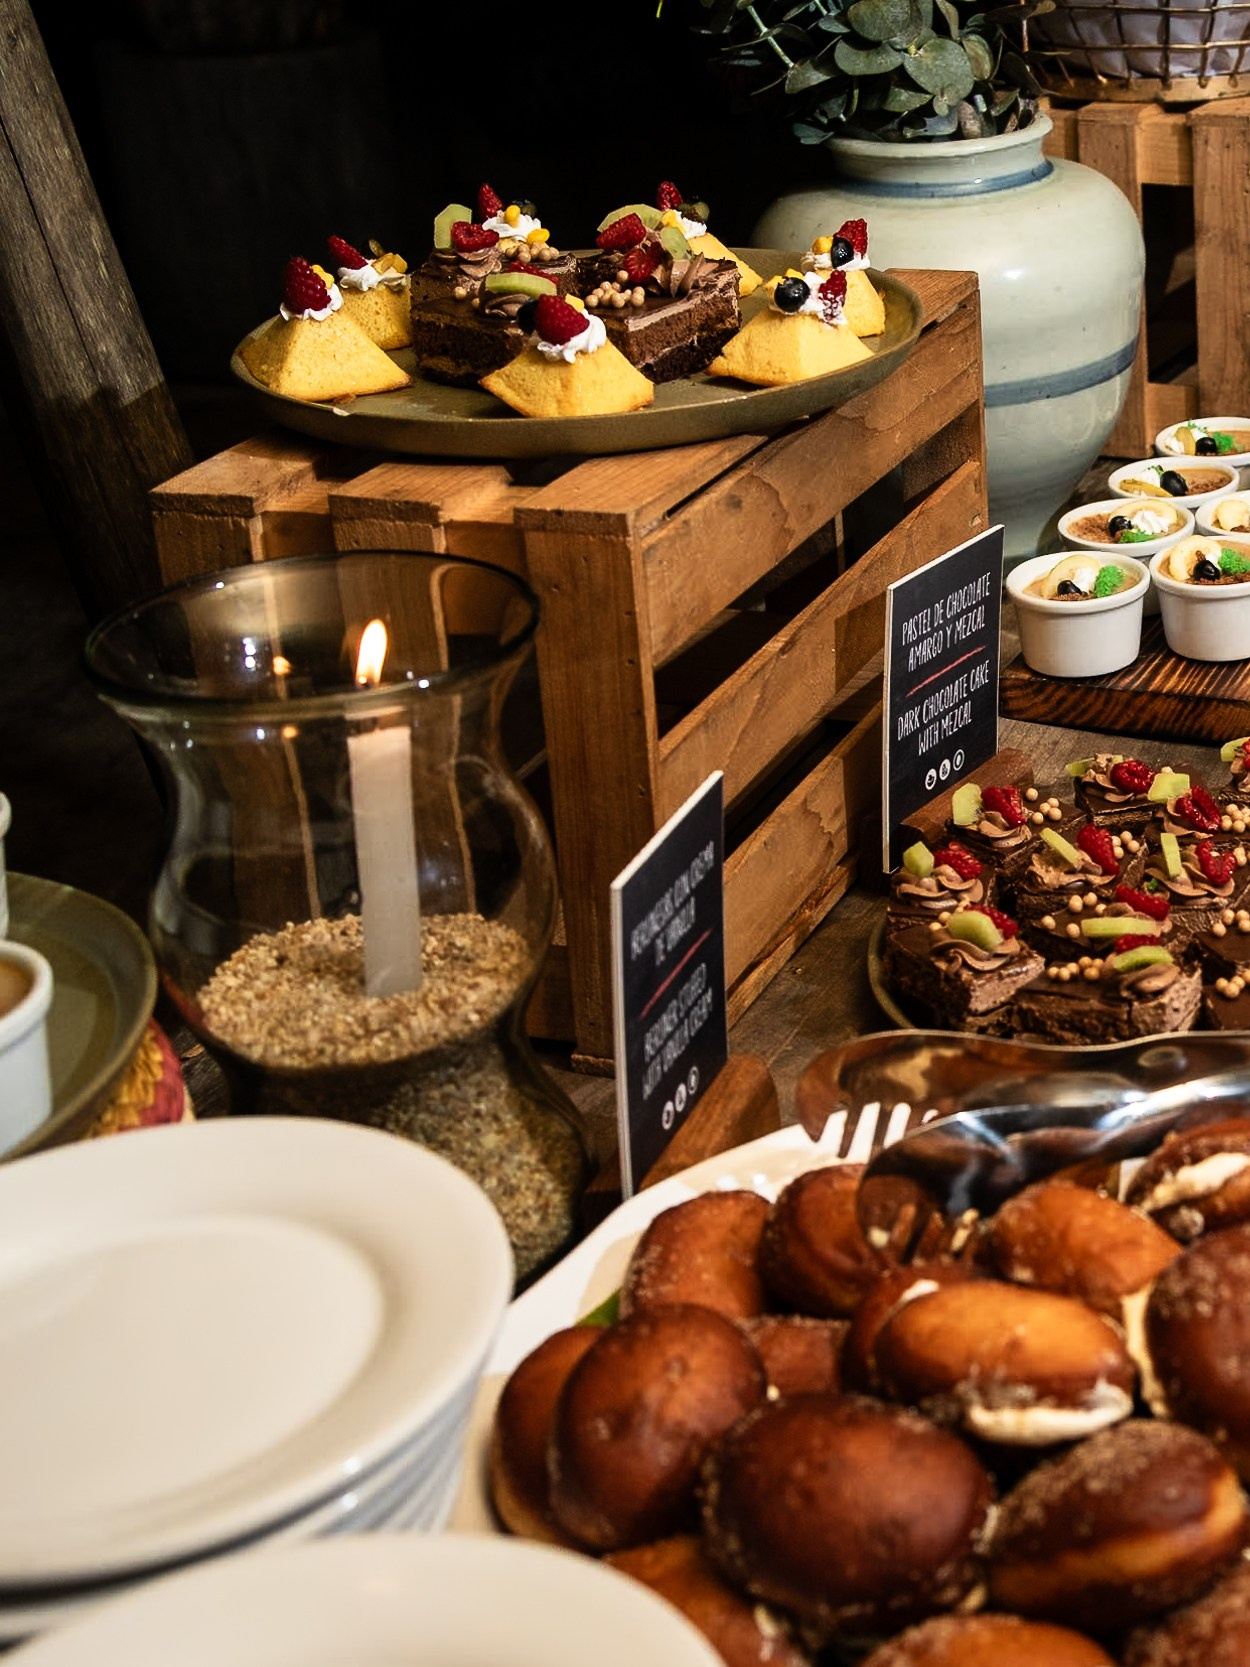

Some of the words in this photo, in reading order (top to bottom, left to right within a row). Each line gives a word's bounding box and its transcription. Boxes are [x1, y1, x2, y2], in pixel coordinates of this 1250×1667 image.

[902, 607, 931, 646] PASTEL
[933, 599, 944, 628] DE
[946, 572, 991, 619] CHOCOLATE
[908, 630, 944, 673] AMARGO
[946, 624, 953, 648] Y
[954, 605, 985, 645] MEZCAL
[897, 705, 920, 741] DARK
[922, 674, 968, 724] CHOCOLATE
[969, 659, 990, 692] CAKE
[918, 721, 939, 756] WITH
[941, 700, 972, 739] MEZCAL
